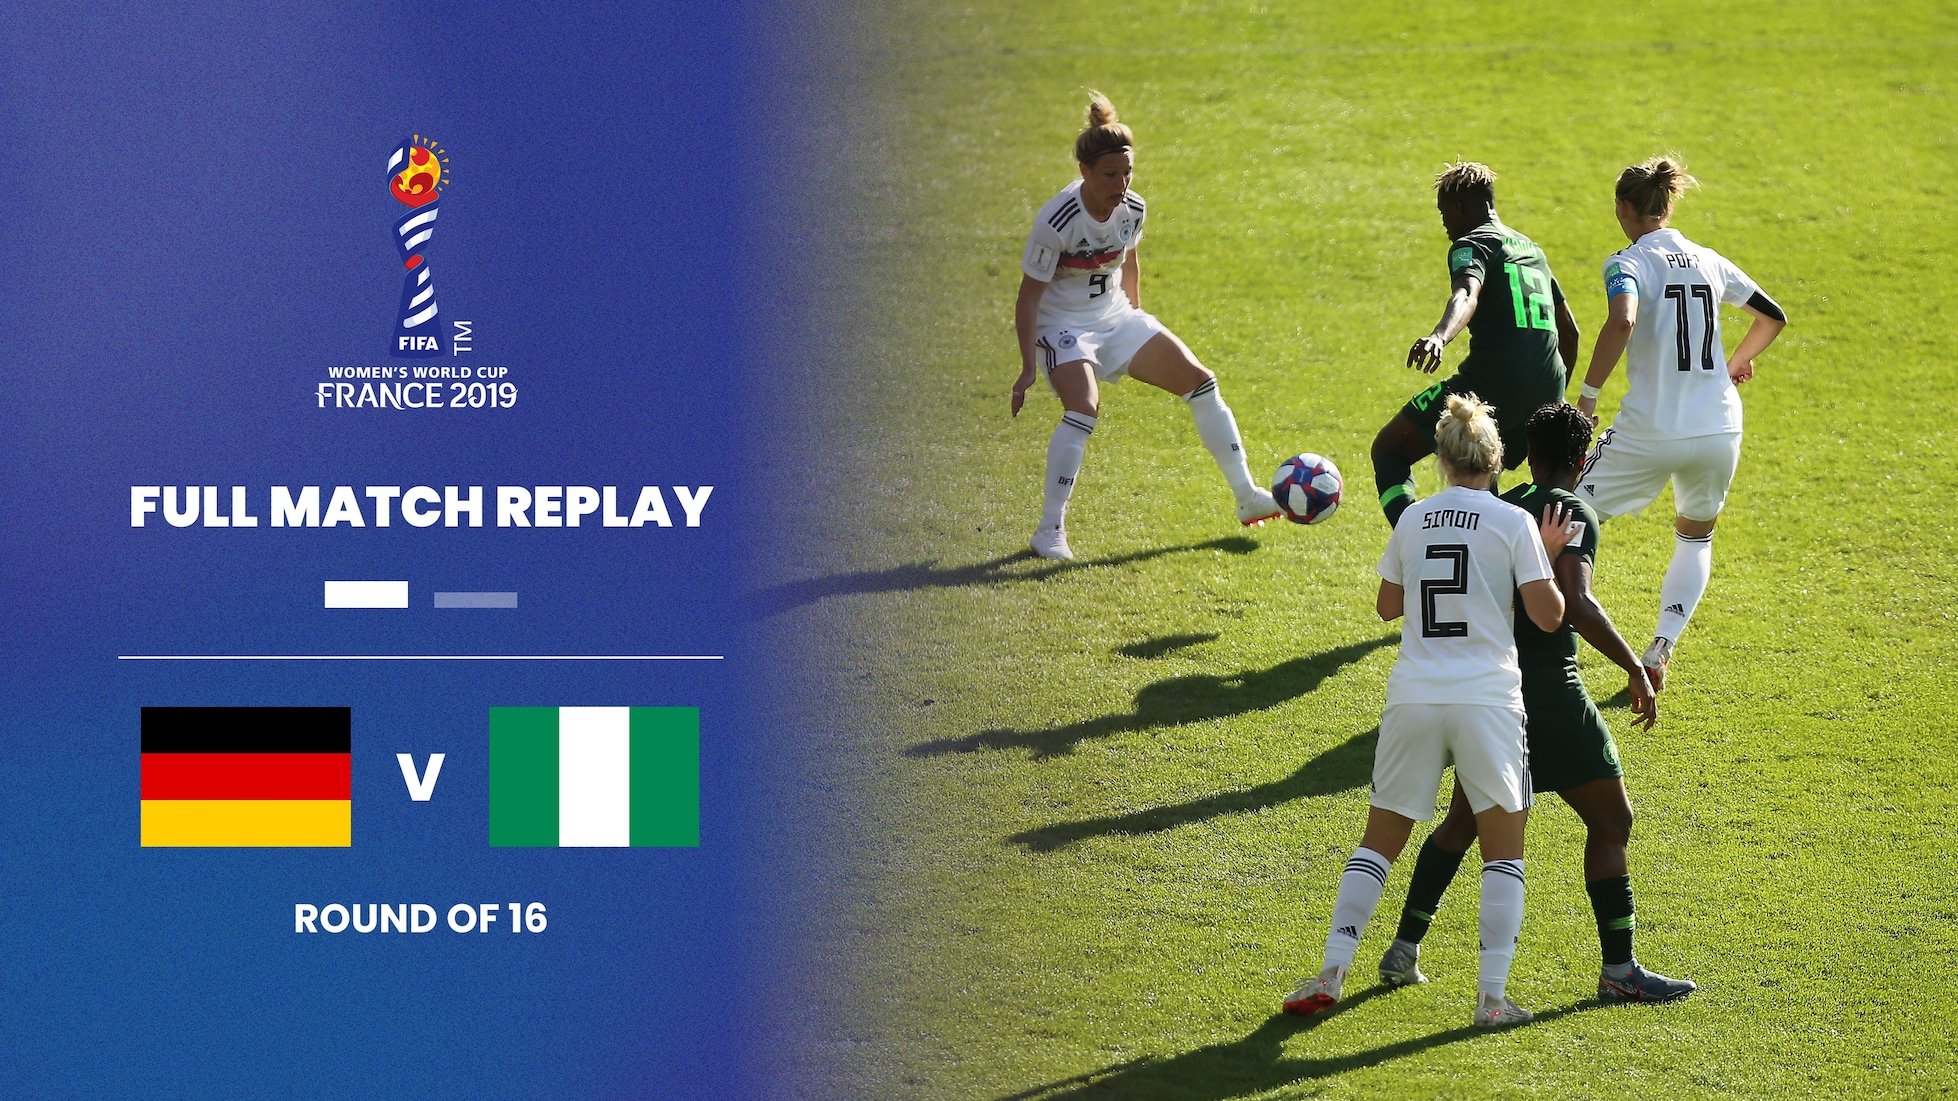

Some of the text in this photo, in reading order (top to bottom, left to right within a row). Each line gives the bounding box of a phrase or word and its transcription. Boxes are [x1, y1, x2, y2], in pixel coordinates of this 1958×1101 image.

[1088, 273, 1109, 299] 9
[1503, 262, 1557, 333] 12
[1422, 509, 1480, 530] SIMON
[1420, 544, 1468, 638] 2
